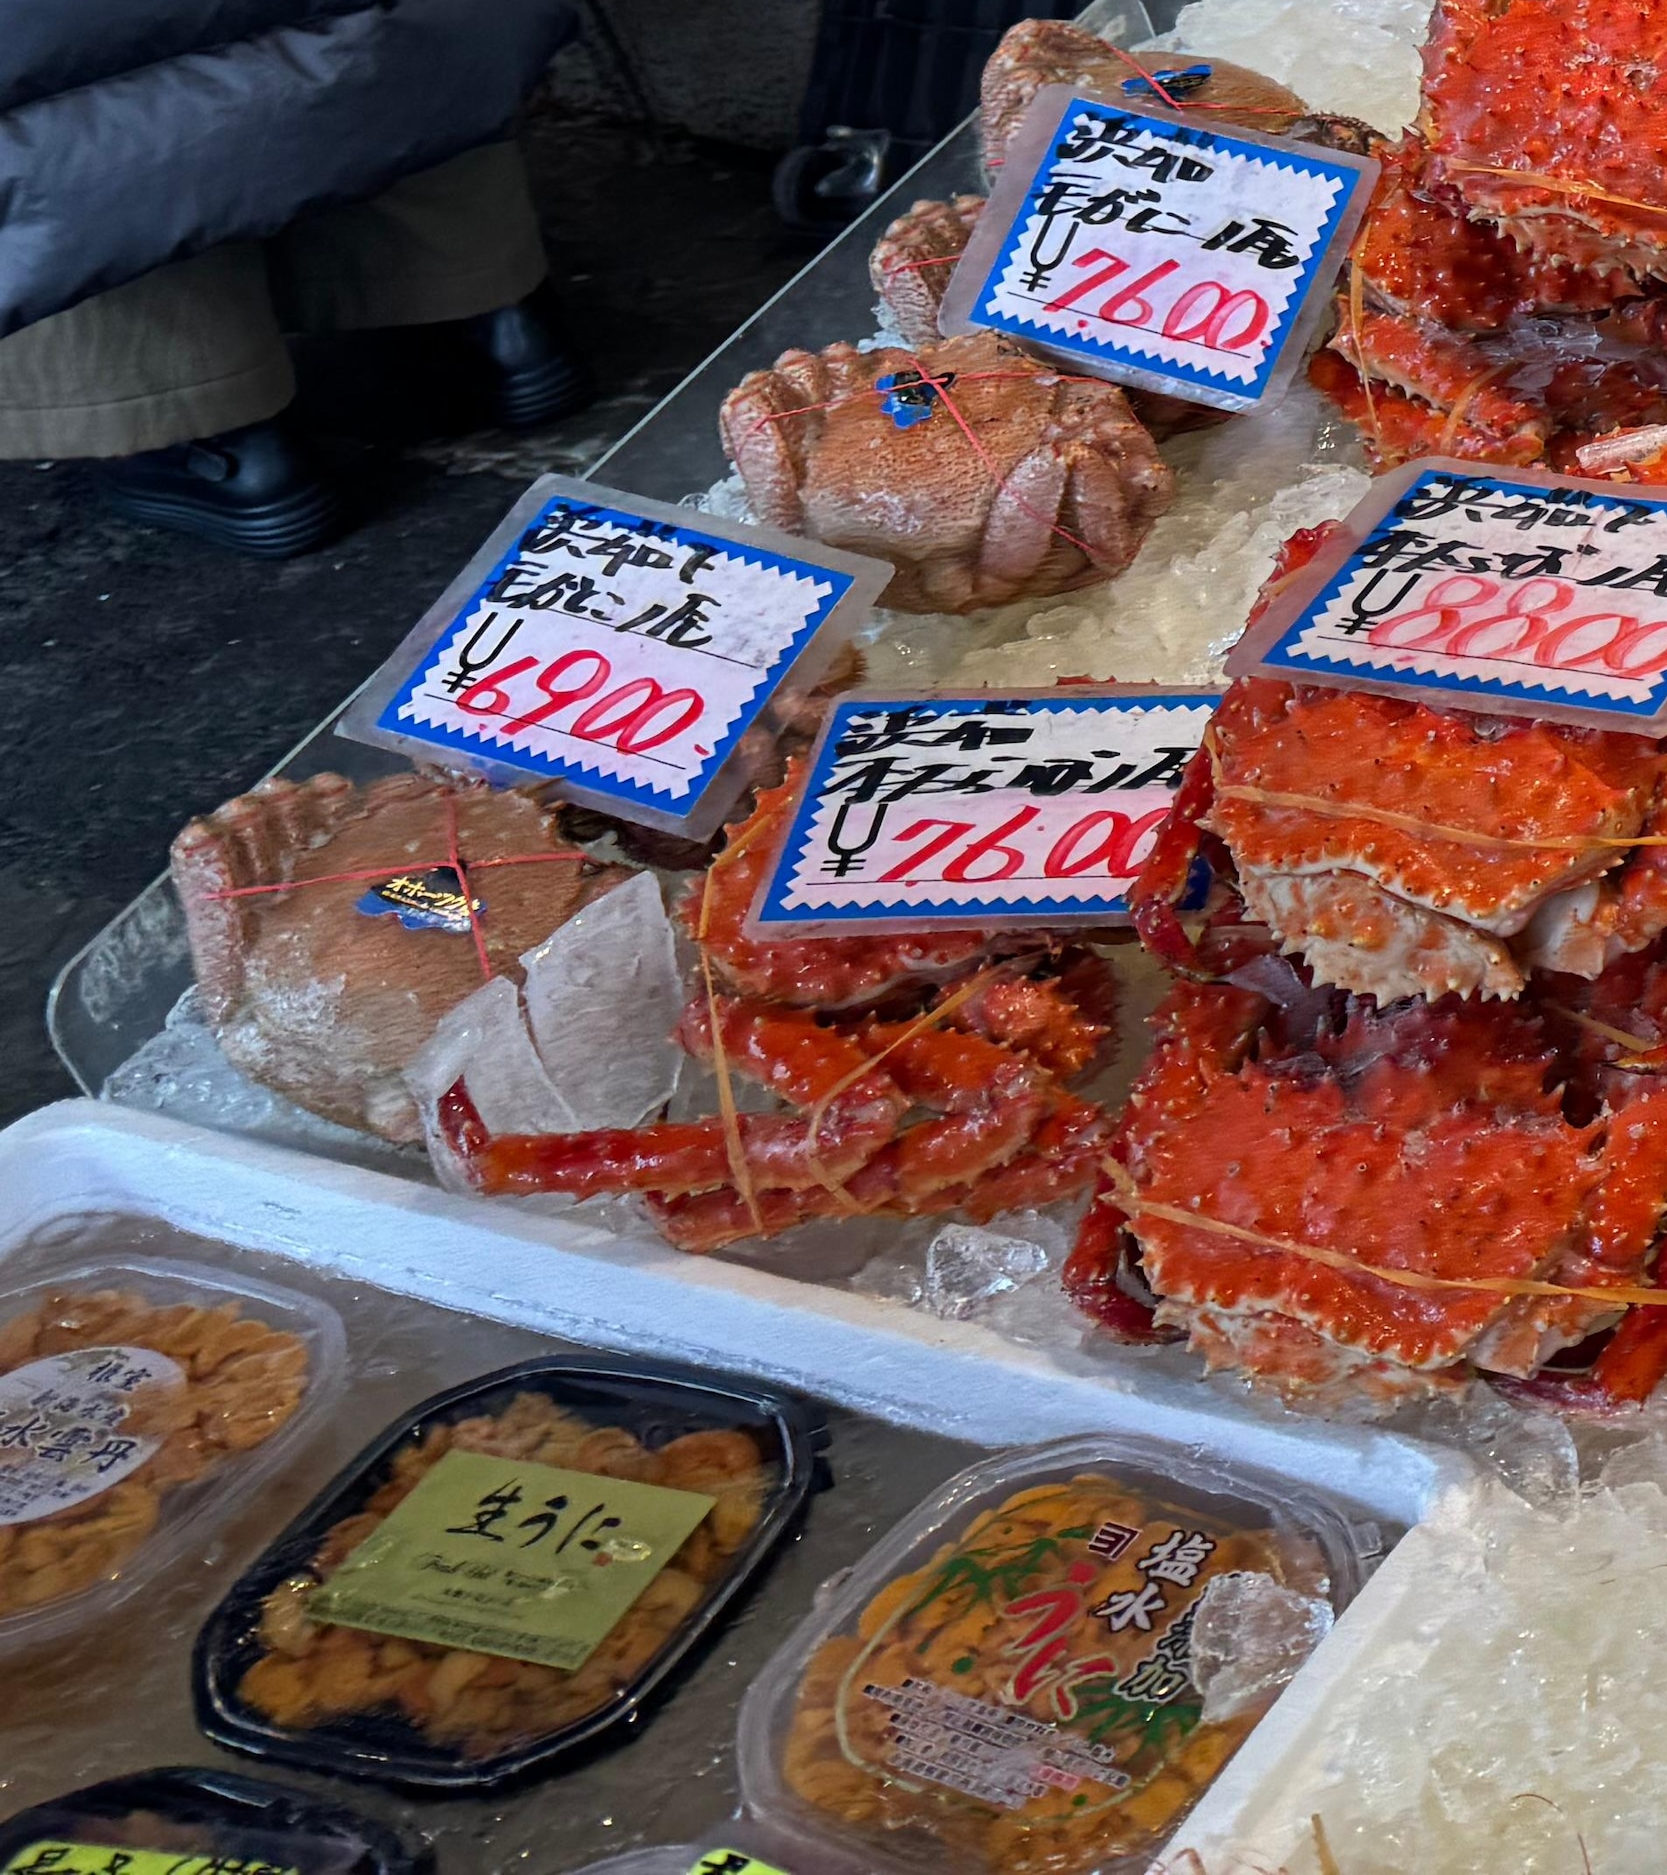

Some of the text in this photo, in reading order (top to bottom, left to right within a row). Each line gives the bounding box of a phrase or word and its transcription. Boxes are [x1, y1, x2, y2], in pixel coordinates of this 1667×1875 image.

[0, 1415, 138, 1474] 水雲丹
[444, 1476, 622, 1555] 生うに
